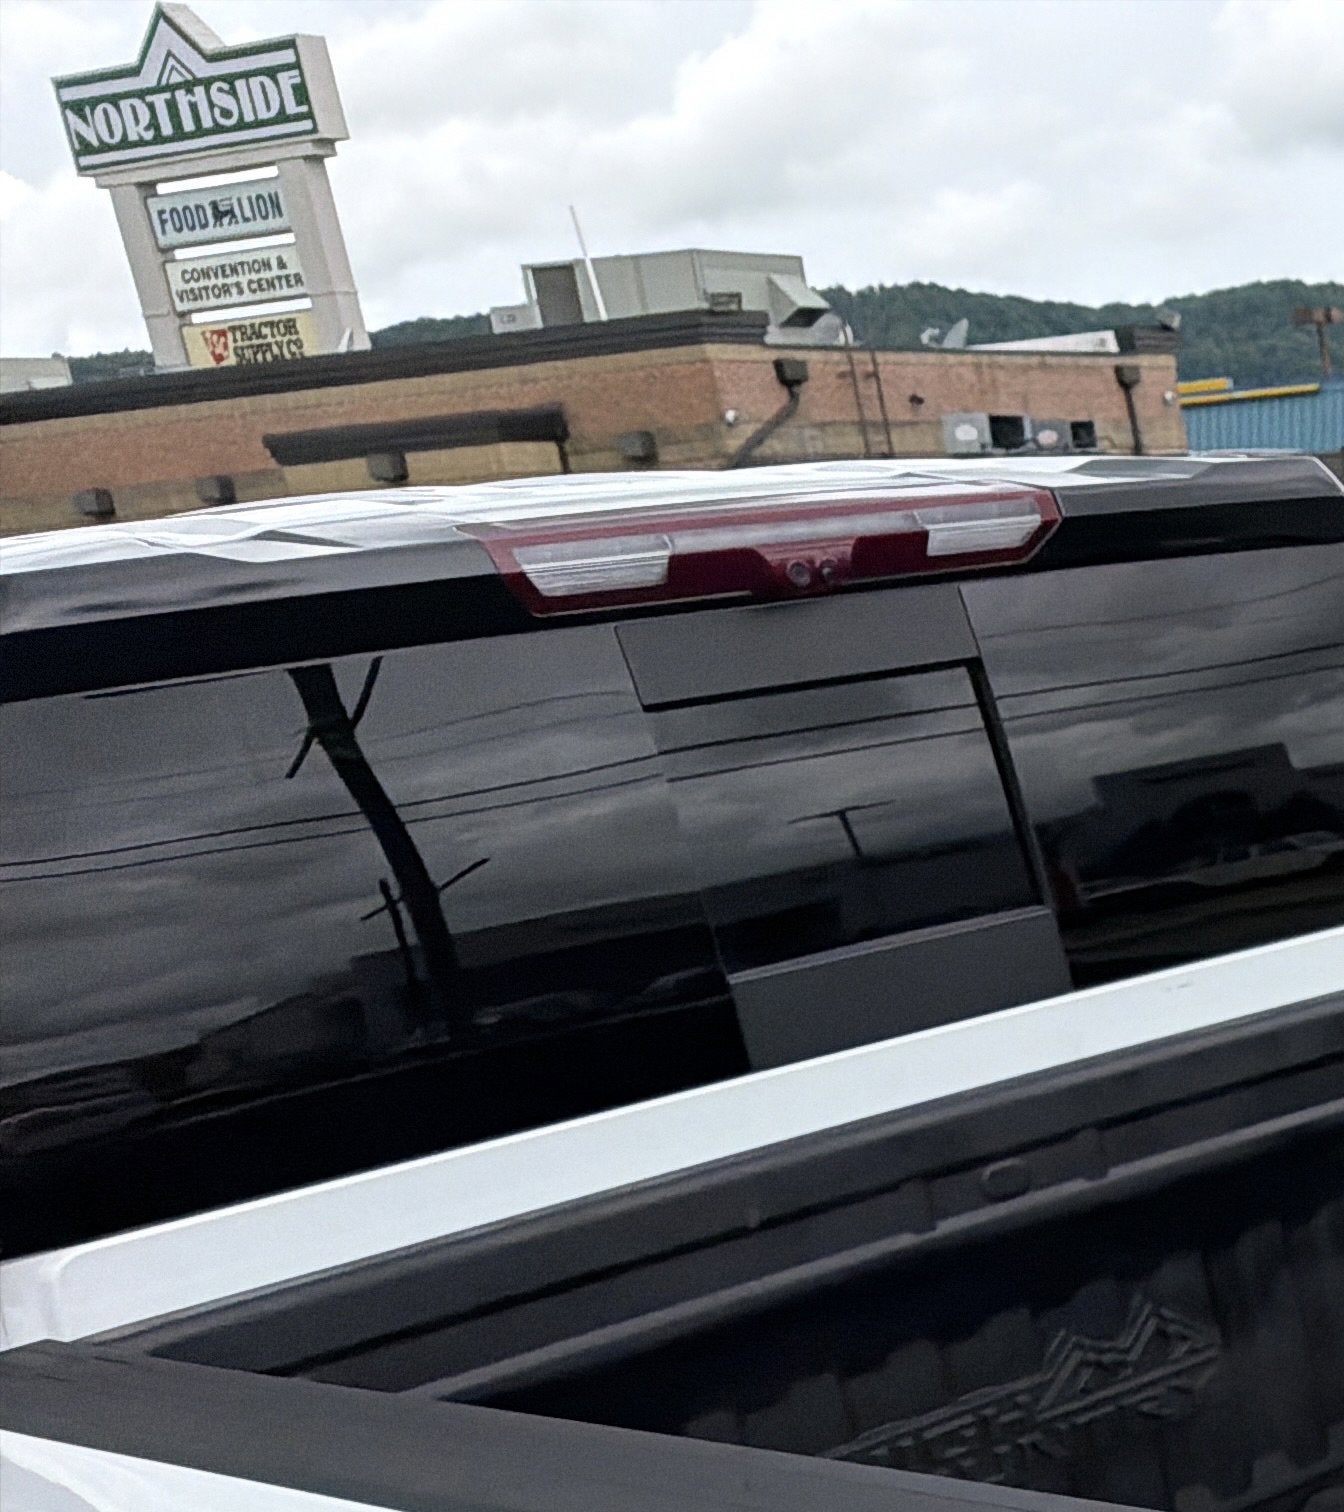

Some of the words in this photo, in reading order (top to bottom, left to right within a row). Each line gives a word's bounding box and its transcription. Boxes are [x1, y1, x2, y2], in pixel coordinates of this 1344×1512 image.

[64, 69, 309, 150] NORTHSIDE
[157, 203, 209, 236] FOOD
[236, 191, 284, 223] LION
[181, 257, 273, 284] CONVENTION
[276, 255, 288, 270] &
[176, 280, 245, 303] VISITOR'S
[247, 272, 305, 294] CENTER
[227, 317, 300, 343] TRACTOR
[233, 340, 284, 366] SUPPLY
